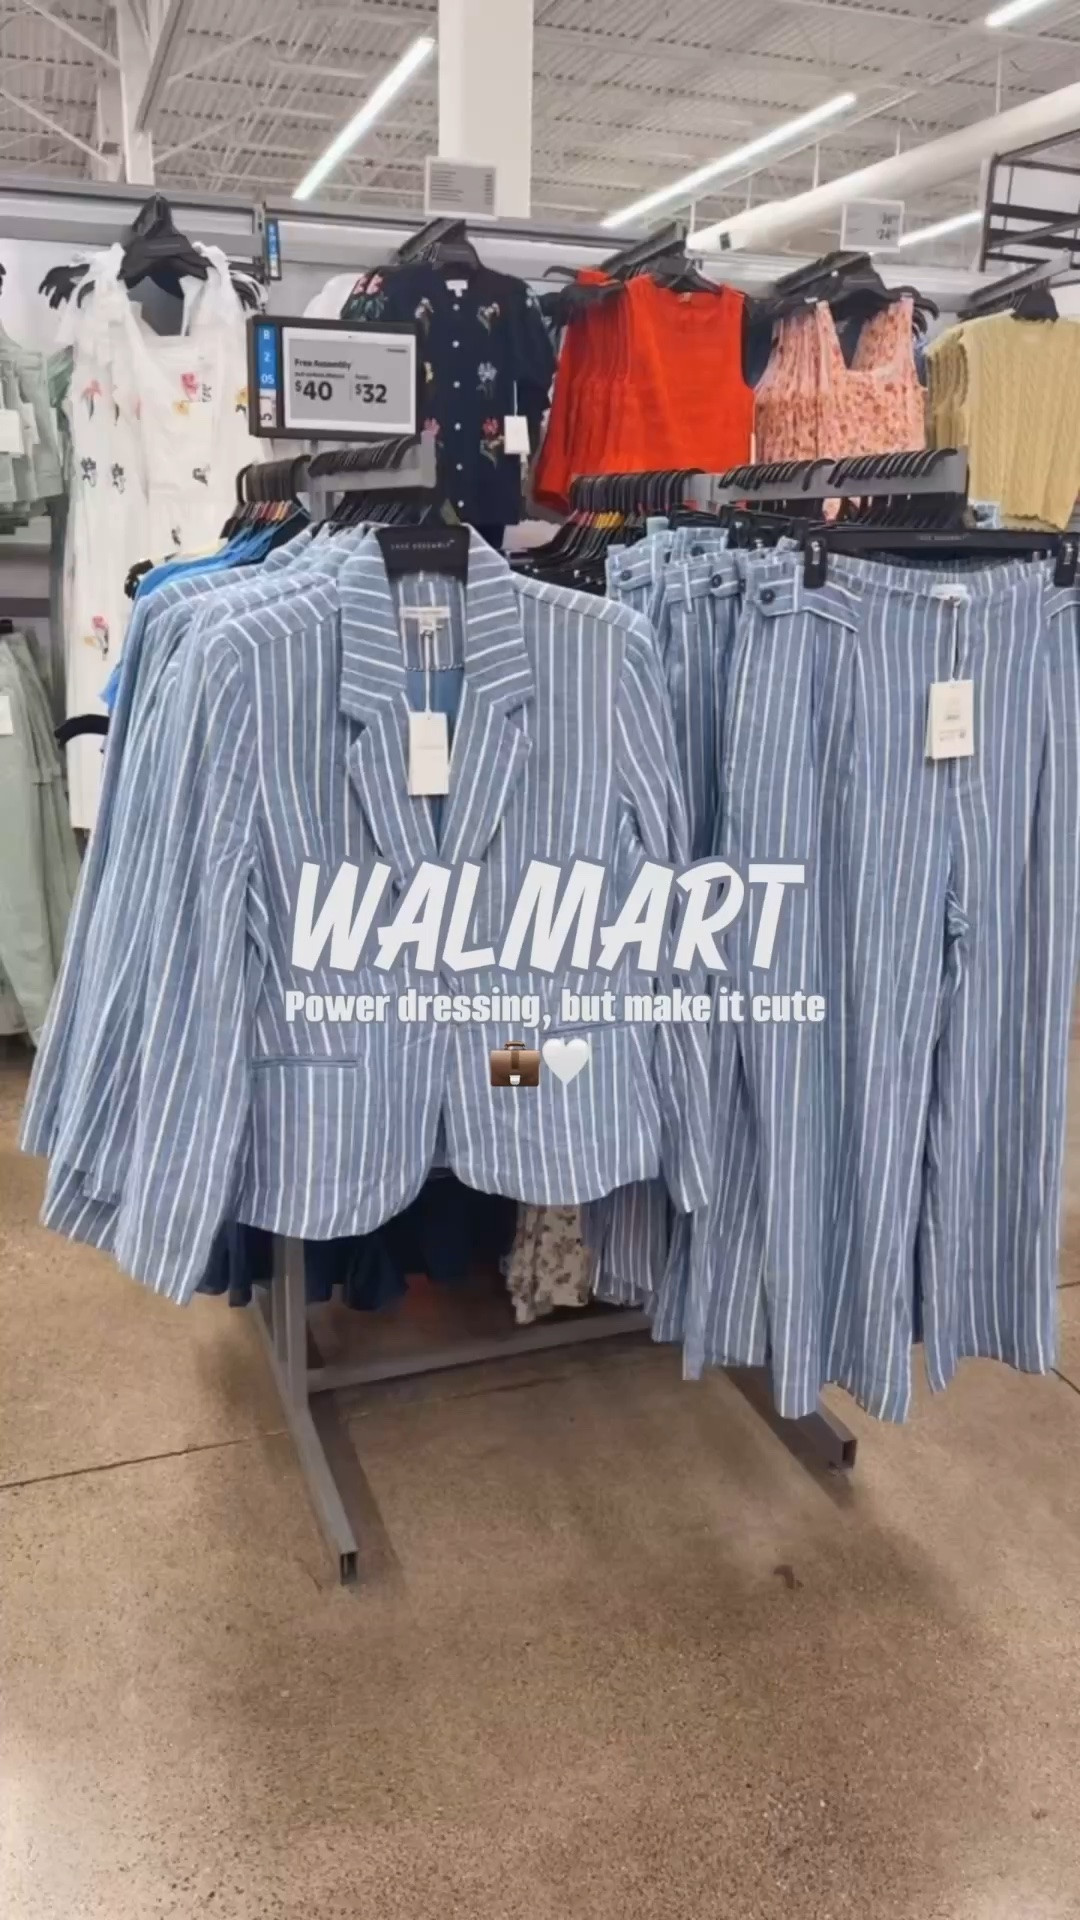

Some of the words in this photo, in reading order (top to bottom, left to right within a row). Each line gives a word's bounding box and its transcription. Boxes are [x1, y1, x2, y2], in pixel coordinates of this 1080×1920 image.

[263, 329, 270, 340] B
[263, 352, 270, 362] 2
[261, 374, 275, 385] 05
[294, 380, 333, 401] $40
[355, 383, 388, 405] $32
